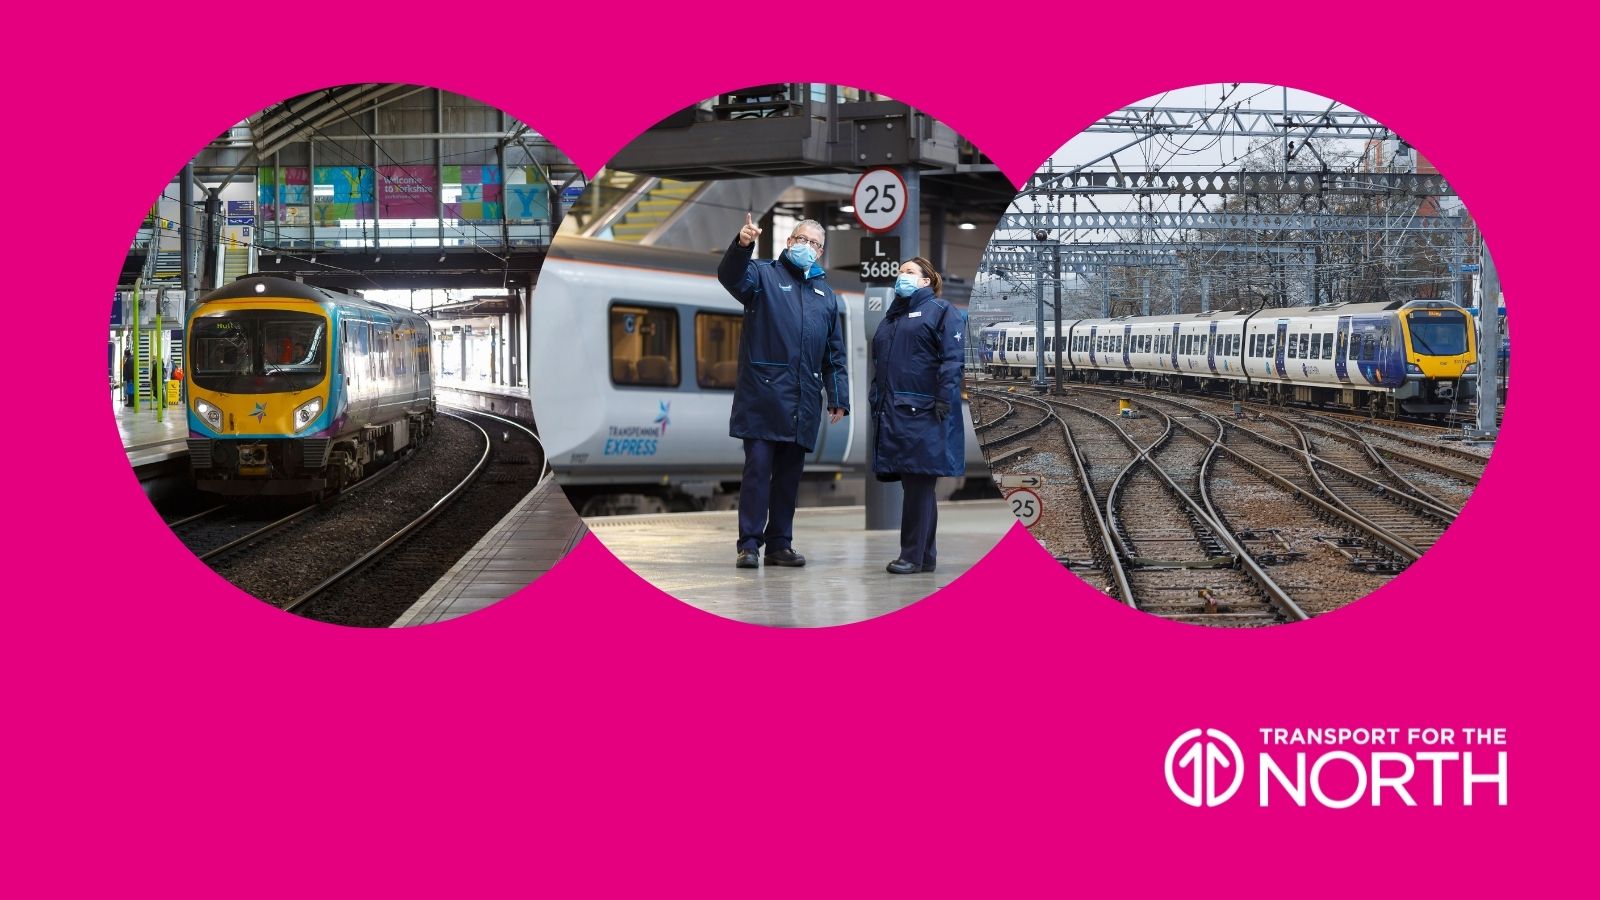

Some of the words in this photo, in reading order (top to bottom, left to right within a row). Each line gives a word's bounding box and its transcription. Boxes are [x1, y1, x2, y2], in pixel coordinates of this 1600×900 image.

[343, 169, 366, 198] Y
[383, 175, 422, 184] Welcome
[384, 185, 393, 193] to
[394, 184, 433, 193] Yorkshire
[466, 185, 478, 200] Y
[514, 188, 539, 217] Y
[864, 184, 897, 214] 25
[875, 240, 886, 257] L
[860, 261, 899, 278] 3688
[609, 426, 659, 437] TRANSPENNINE
[604, 438, 658, 456] EXPRESS
[1012, 499, 1035, 518] 25
